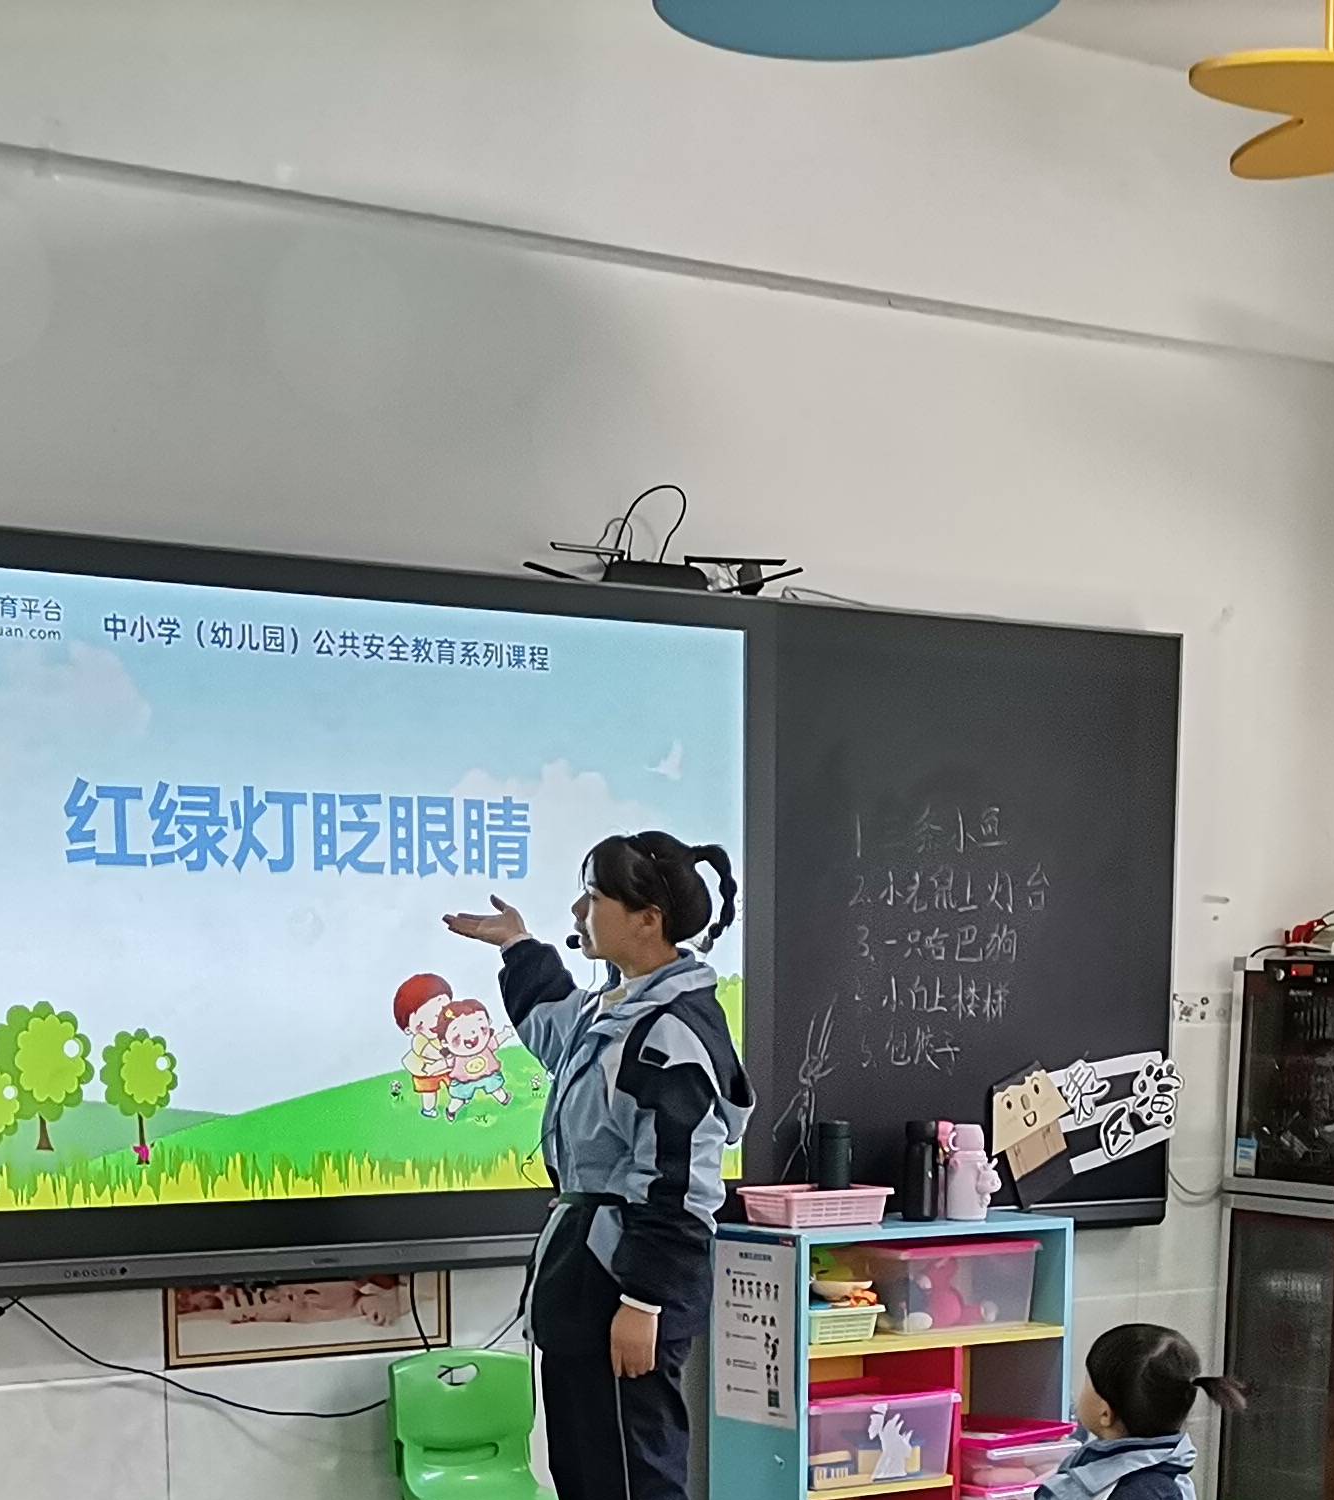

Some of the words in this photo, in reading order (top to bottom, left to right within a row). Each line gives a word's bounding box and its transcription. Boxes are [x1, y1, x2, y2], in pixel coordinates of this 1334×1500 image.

[63, 776, 532, 881] 红绿灯眨眼睛
